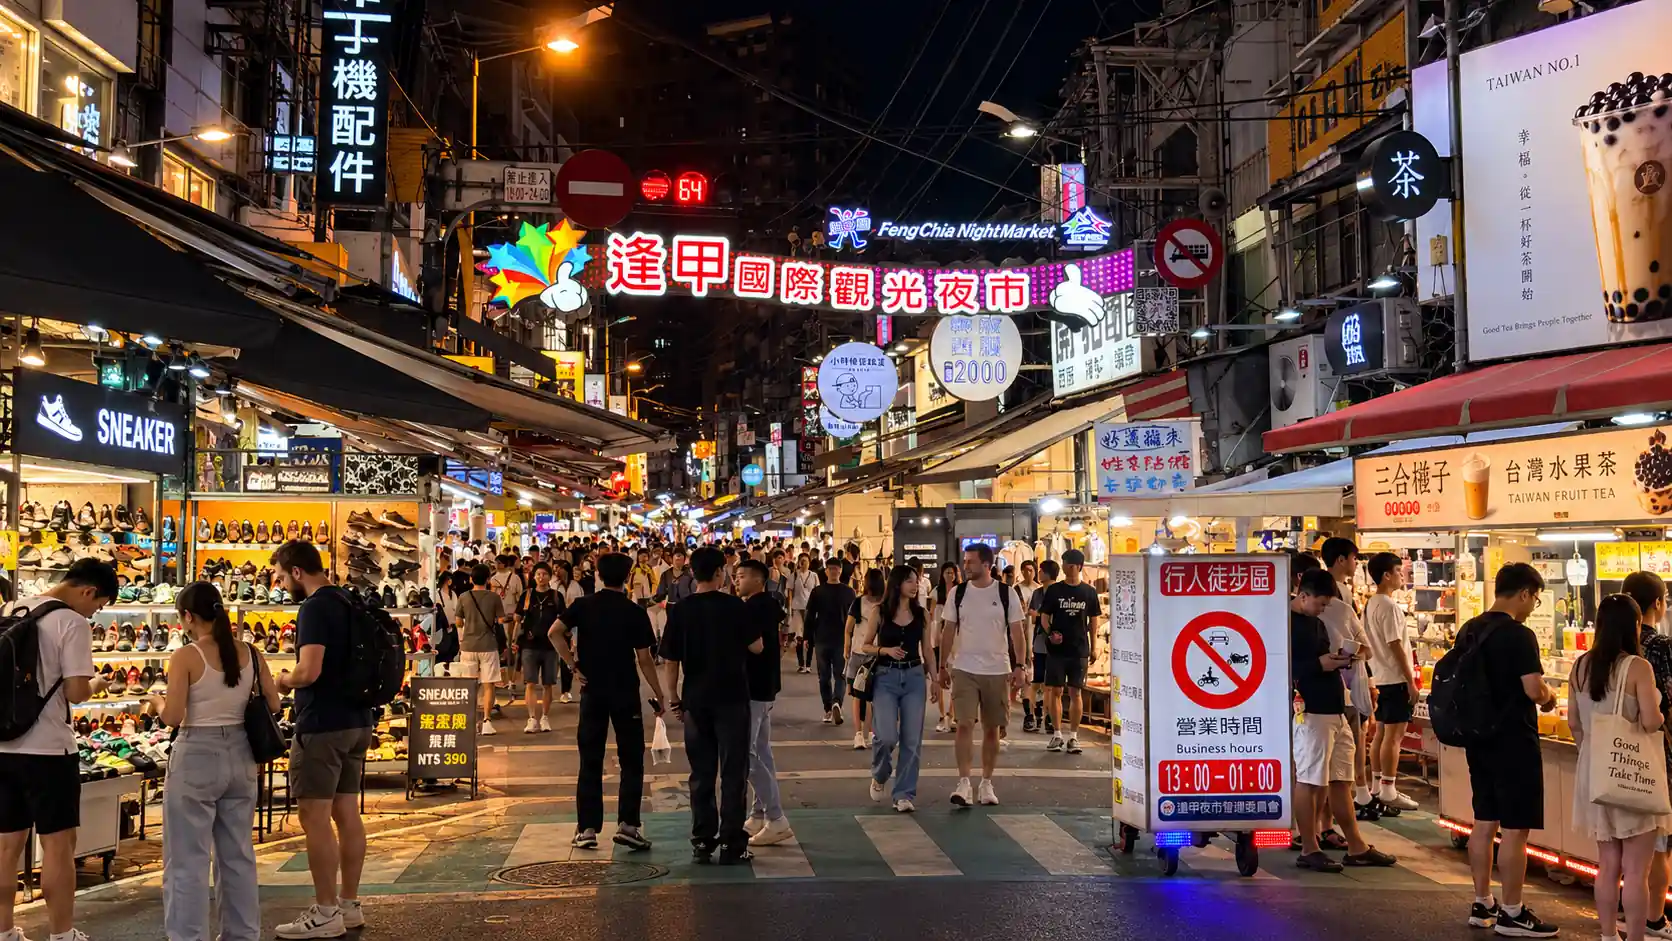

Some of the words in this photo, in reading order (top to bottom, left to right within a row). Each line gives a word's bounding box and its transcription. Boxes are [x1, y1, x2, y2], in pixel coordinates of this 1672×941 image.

[1486, 64, 1542, 91] TAIWAN
[1548, 54, 1579, 75] NO.1
[1388, 150, 1425, 199] 茶
[679, 179, 702, 201] 64
[877, 221, 955, 241] FengChia
[958, 221, 1055, 240] NightMarket
[606, 232, 1028, 314] 逢甲國際觀光夜市
[1482, 325, 1500, 334] Good
[954, 359, 1007, 384] 2000
[97, 408, 175, 455] SNEAKER
[1505, 451, 1617, 484] 台灣水果茶
[1508, 491, 1550, 504] TAIWAN
[1554, 489, 1588, 501] FRUIT
[1592, 487, 1616, 500] TEA
[1165, 564, 1270, 593] 行人徒步區
[418, 688, 469, 701] SNEAKER
[1176, 716, 1262, 736] 營業時間
[1176, 743, 1226, 754] Business
[1230, 742, 1264, 754] hours
[443, 753, 467, 766] 390
